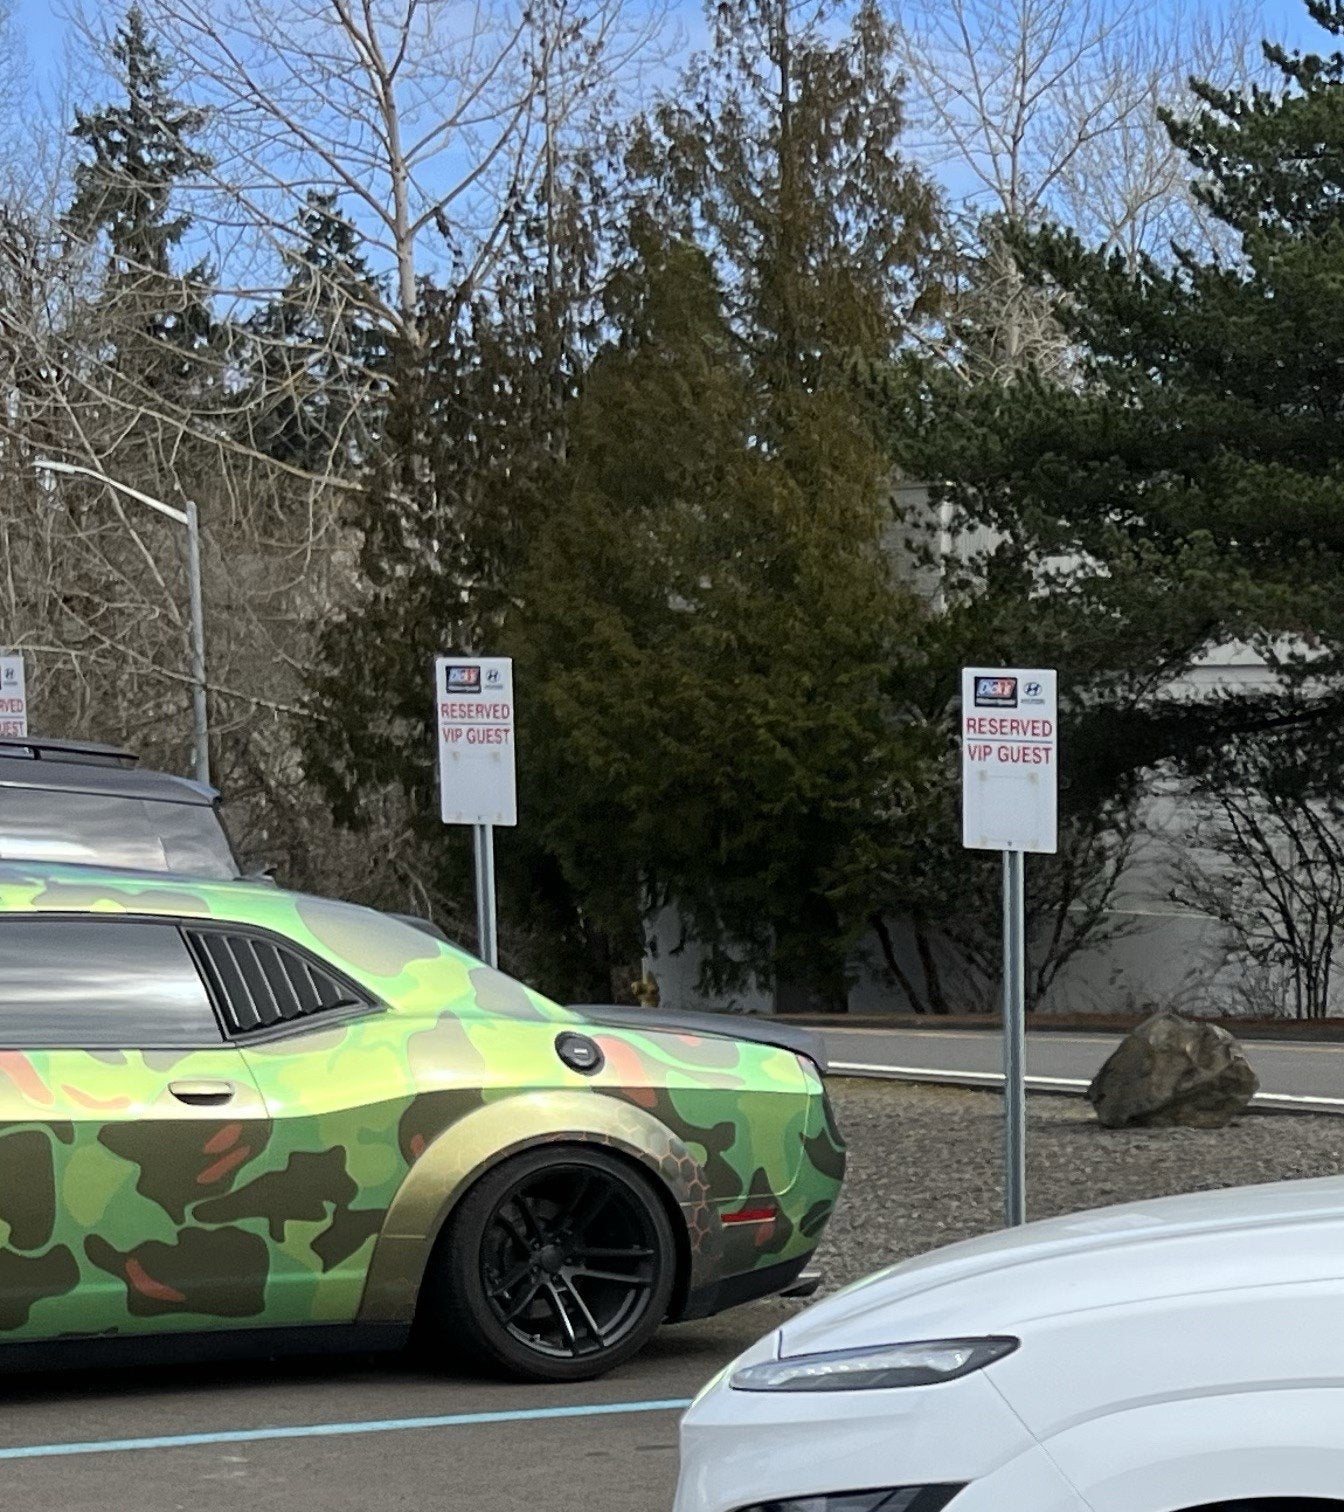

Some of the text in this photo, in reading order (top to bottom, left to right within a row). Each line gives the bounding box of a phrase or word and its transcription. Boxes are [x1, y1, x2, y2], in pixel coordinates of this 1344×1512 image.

[441, 703, 510, 719] RESERVED
[442, 727, 511, 744] VIP GUEST
[967, 718, 1052, 737] RESERVED
[967, 744, 1052, 764] VIP GUEST
